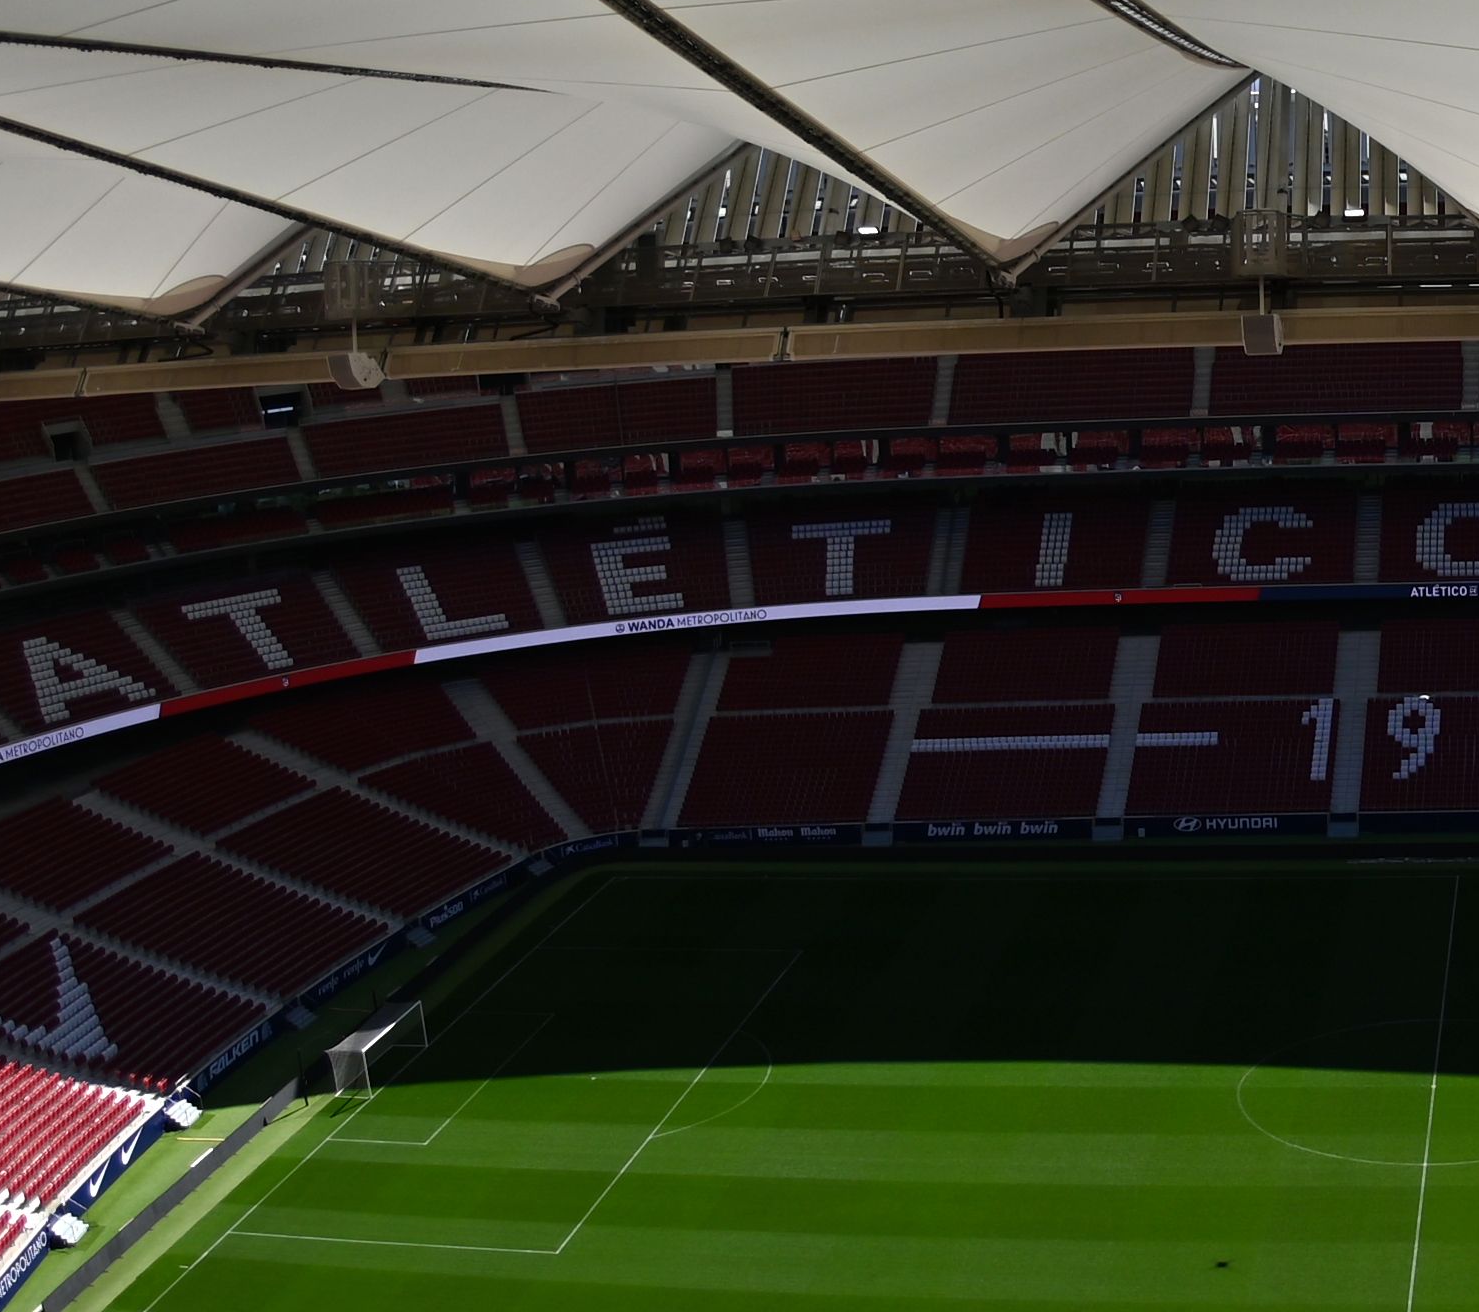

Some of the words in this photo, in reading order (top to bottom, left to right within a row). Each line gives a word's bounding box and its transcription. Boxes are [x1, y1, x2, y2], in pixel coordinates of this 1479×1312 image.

[1410, 584, 1468, 598] ATLÉTICO
[627, 618, 675, 633] WANDA
[677, 609, 768, 627] METROPOLITANO
[5, 726, 85, 760] METROPOLITANO
[927, 822, 966, 837] bwin
[973, 821, 1012, 836] bwin
[1020, 820, 1059, 835] bwin
[1206, 816, 1278, 830] HYUNDAI
[757, 827, 794, 838] Mahou
[800, 826, 837, 837] Mahou
[209, 1028, 259, 1081] FALKEN
